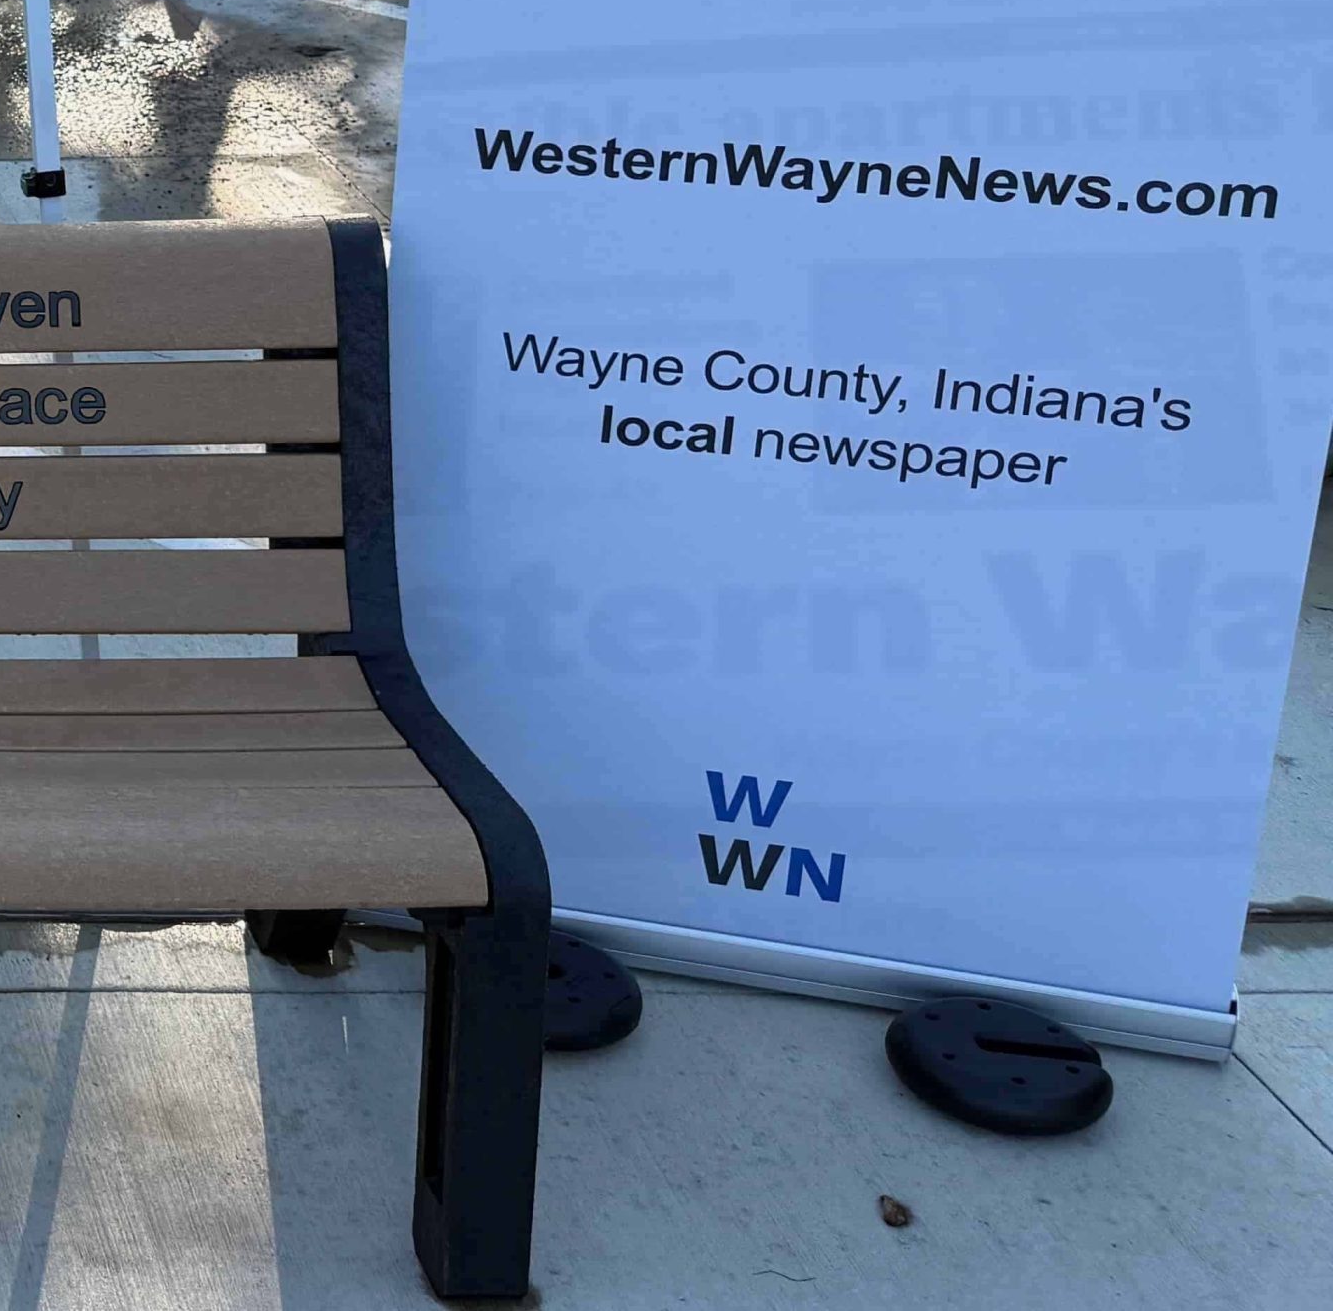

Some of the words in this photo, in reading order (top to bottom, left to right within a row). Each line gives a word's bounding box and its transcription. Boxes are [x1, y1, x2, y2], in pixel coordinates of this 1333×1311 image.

[474, 127, 1278, 219] WesternWayneNews.com
[502, 331, 684, 390] Wayne
[704, 349, 907, 420] County,
[934, 368, 1192, 432] Indiana's
[600, 404, 735, 455] local
[754, 428, 1068, 490] newspaper
[705, 770, 794, 829] W
[698, 833, 847, 903] WN
